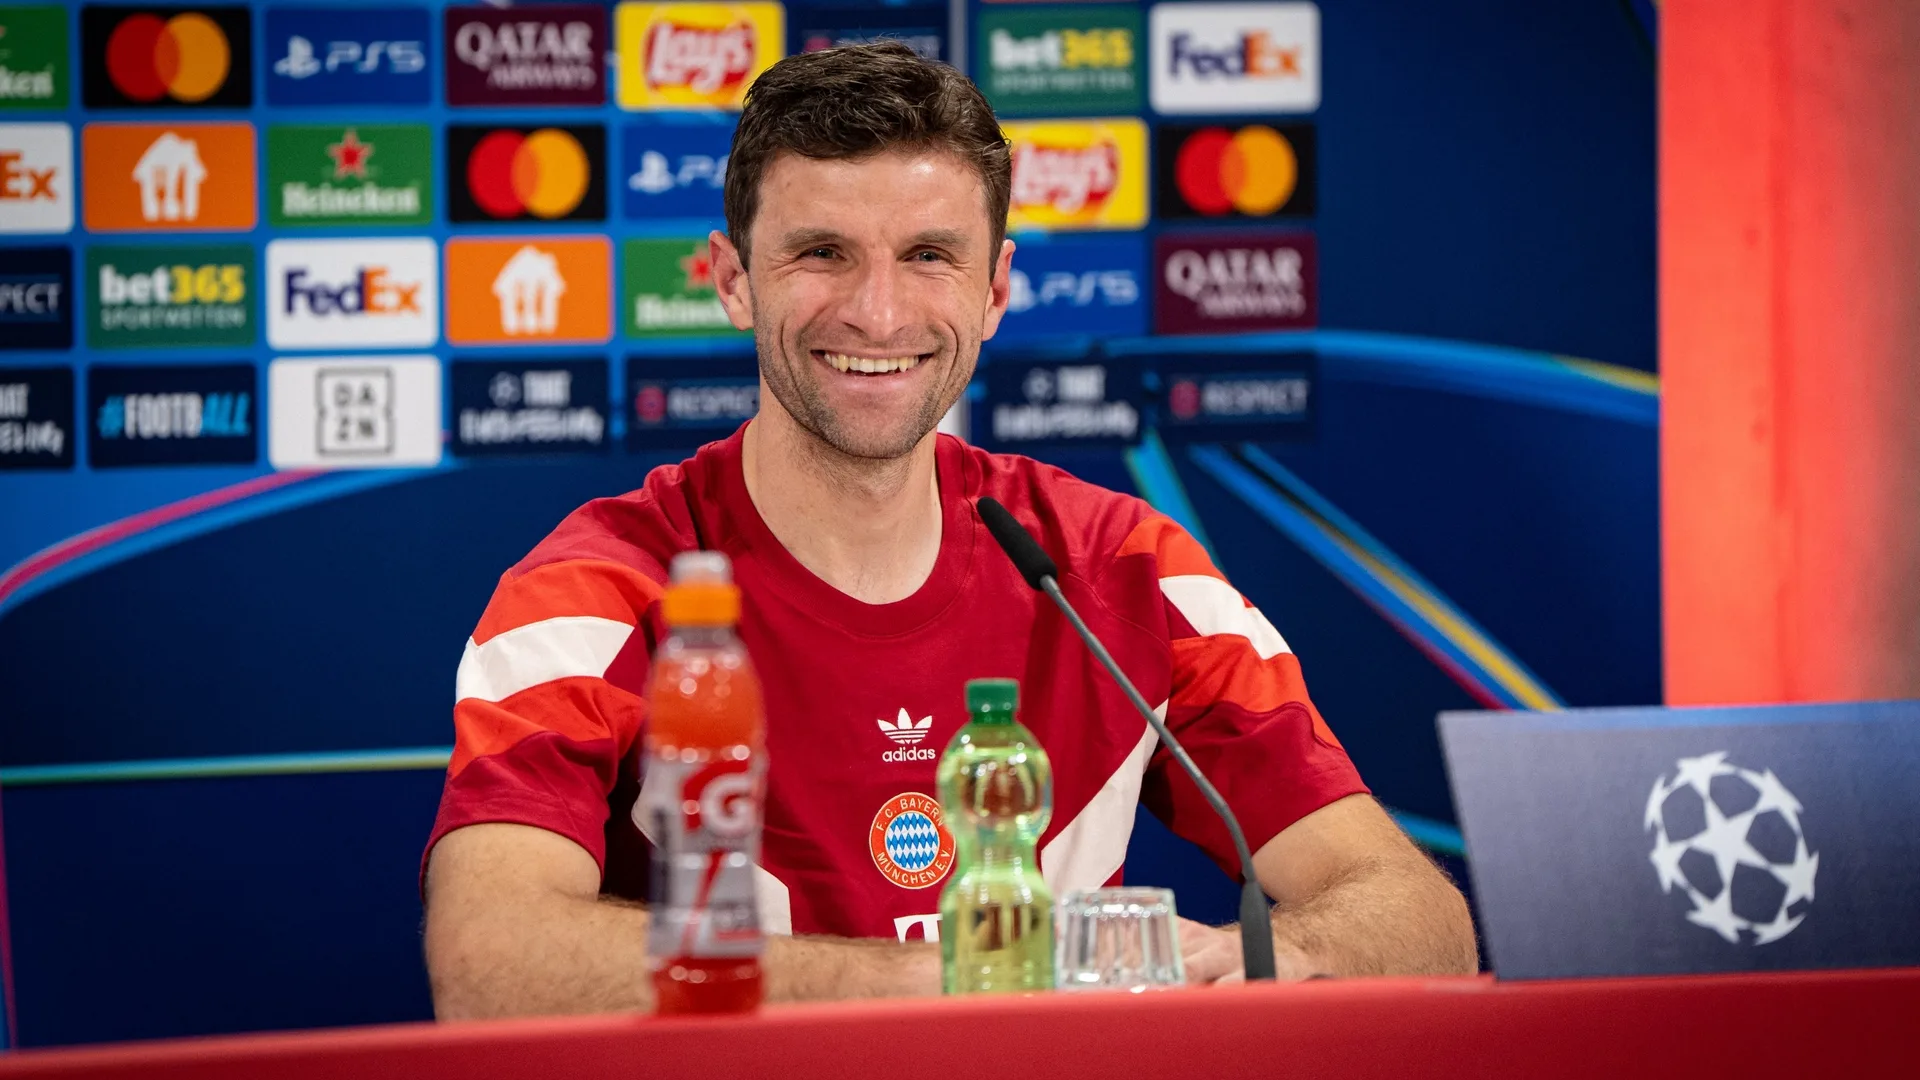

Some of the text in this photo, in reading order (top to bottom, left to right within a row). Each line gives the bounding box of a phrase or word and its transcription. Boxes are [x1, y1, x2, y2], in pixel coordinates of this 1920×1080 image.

[325, 41, 425, 73] PS5
[454, 21, 593, 72] QATAR
[990, 29, 1133, 69] bet365
[1170, 30, 1301, 81] FedEx
[0, 151, 58, 202] Ex
[282, 181, 420, 217] Heineken
[100, 264, 245, 304] bet365
[285, 267, 420, 316] FedEx
[1165, 247, 1303, 301] QATAR
[100, 305, 246, 330] SPORTWETTEN
[97, 391, 249, 439] #FOOTBALL
[882, 747, 936, 763] adidas
[900, 798, 945, 827] BAYERN
[877, 852, 936, 884] MÜNCHEN
